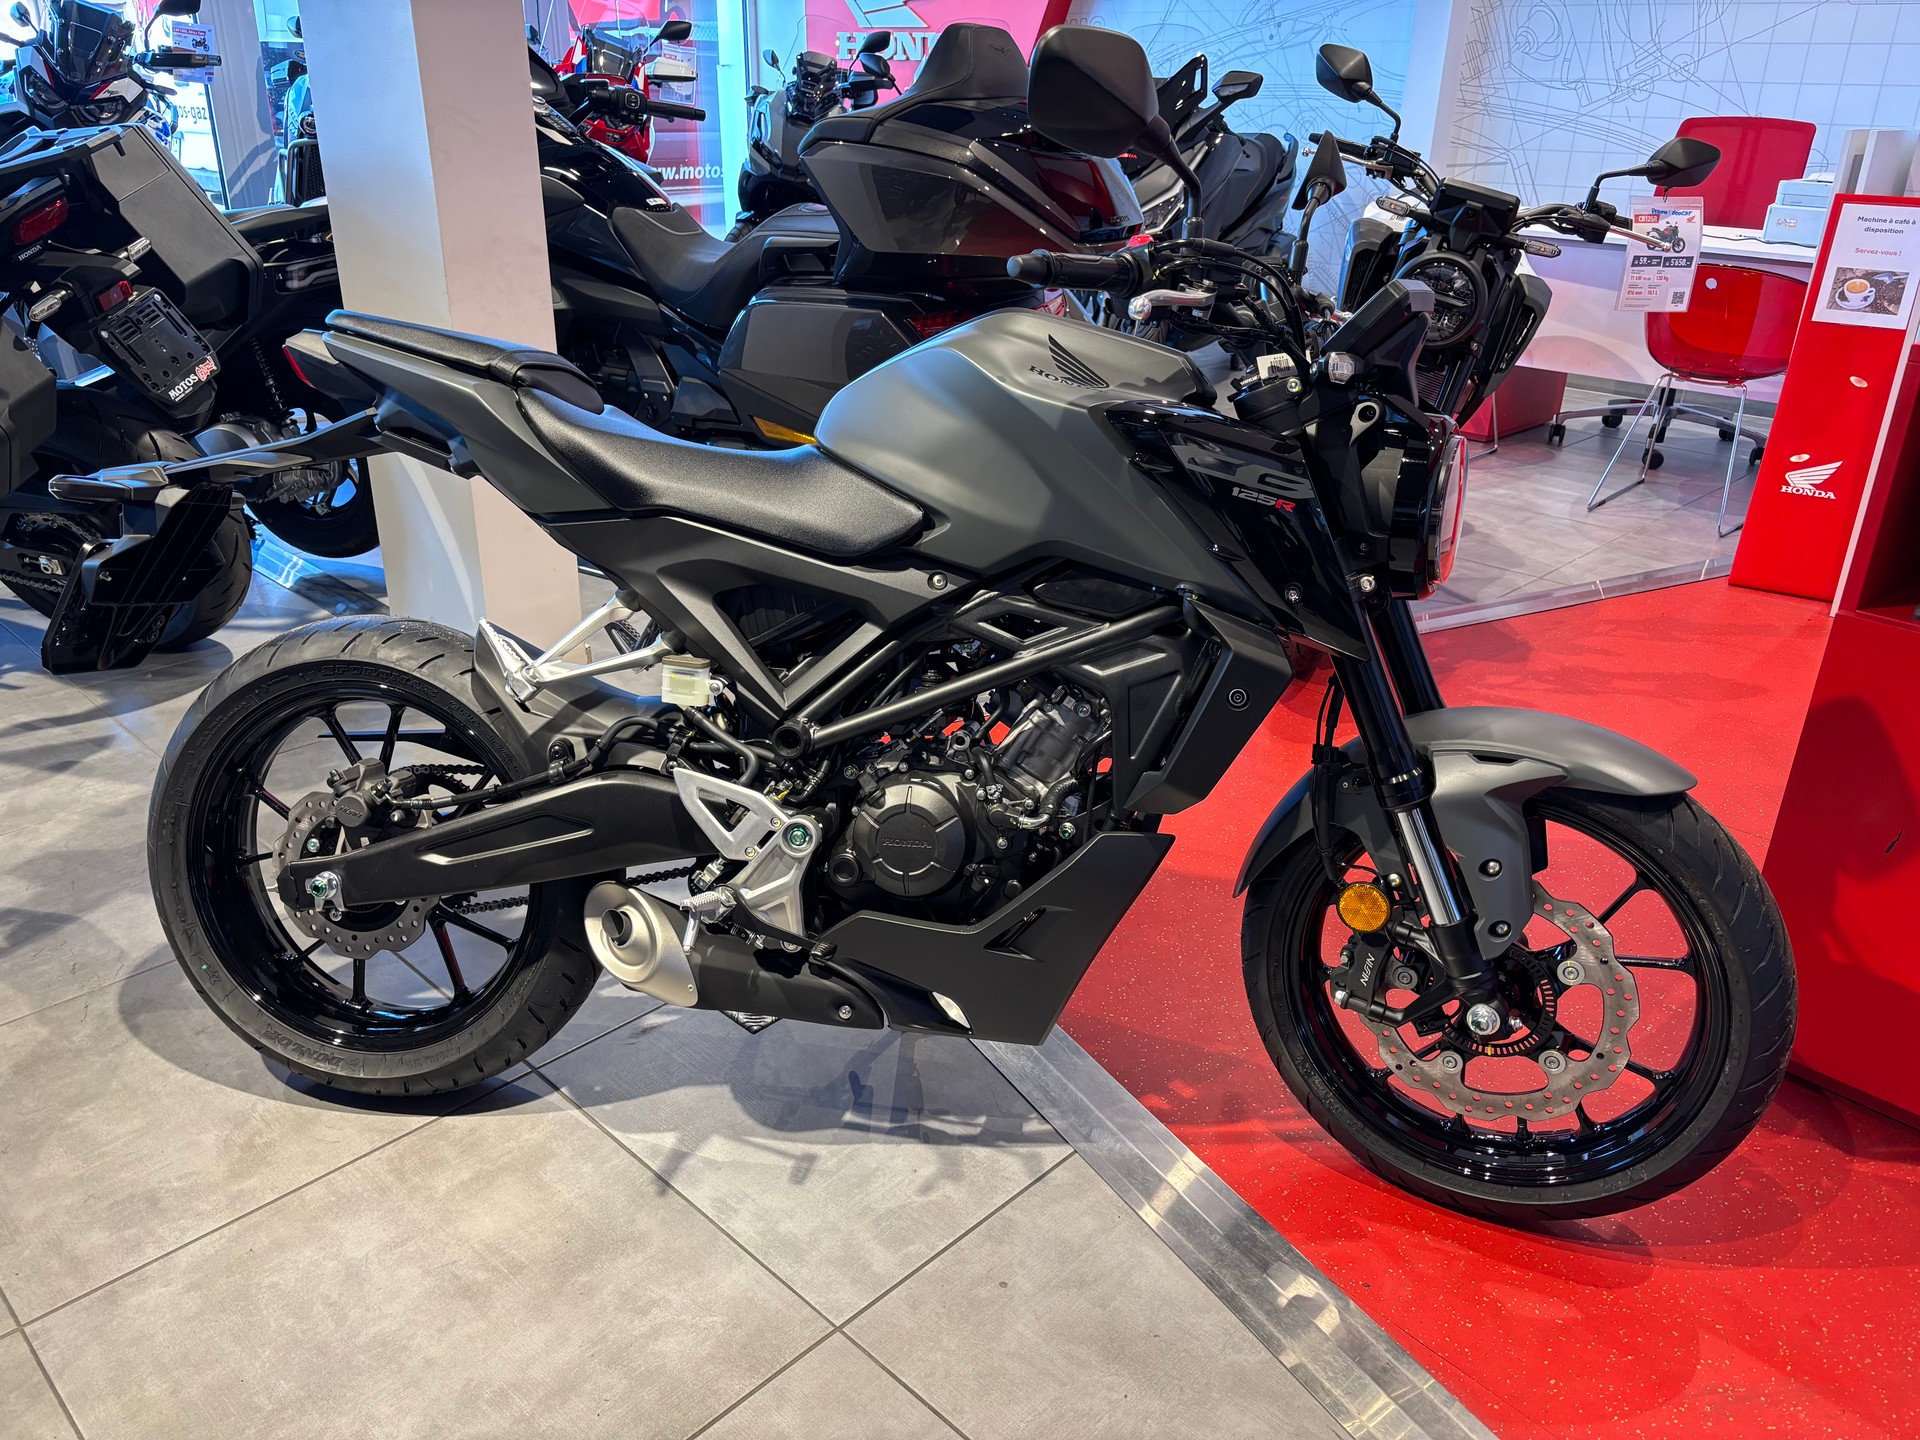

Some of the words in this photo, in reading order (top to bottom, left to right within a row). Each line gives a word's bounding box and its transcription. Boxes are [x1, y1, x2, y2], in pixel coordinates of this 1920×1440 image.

[1857, 216, 1888, 224] Machine
[1894, 218, 1910, 226] café
[1864, 226, 1904, 235] disposition
[18, 244, 42, 261] HONDA
[1855, 247, 1898, 257] Servez-vous
[168, 373, 199, 400] MOTOS
[1232, 487, 1296, 513] 125R
[1780, 485, 1837, 500] HONDA
[881, 838, 932, 849] HONDA
[1360, 952, 1376, 987] NISSIN
